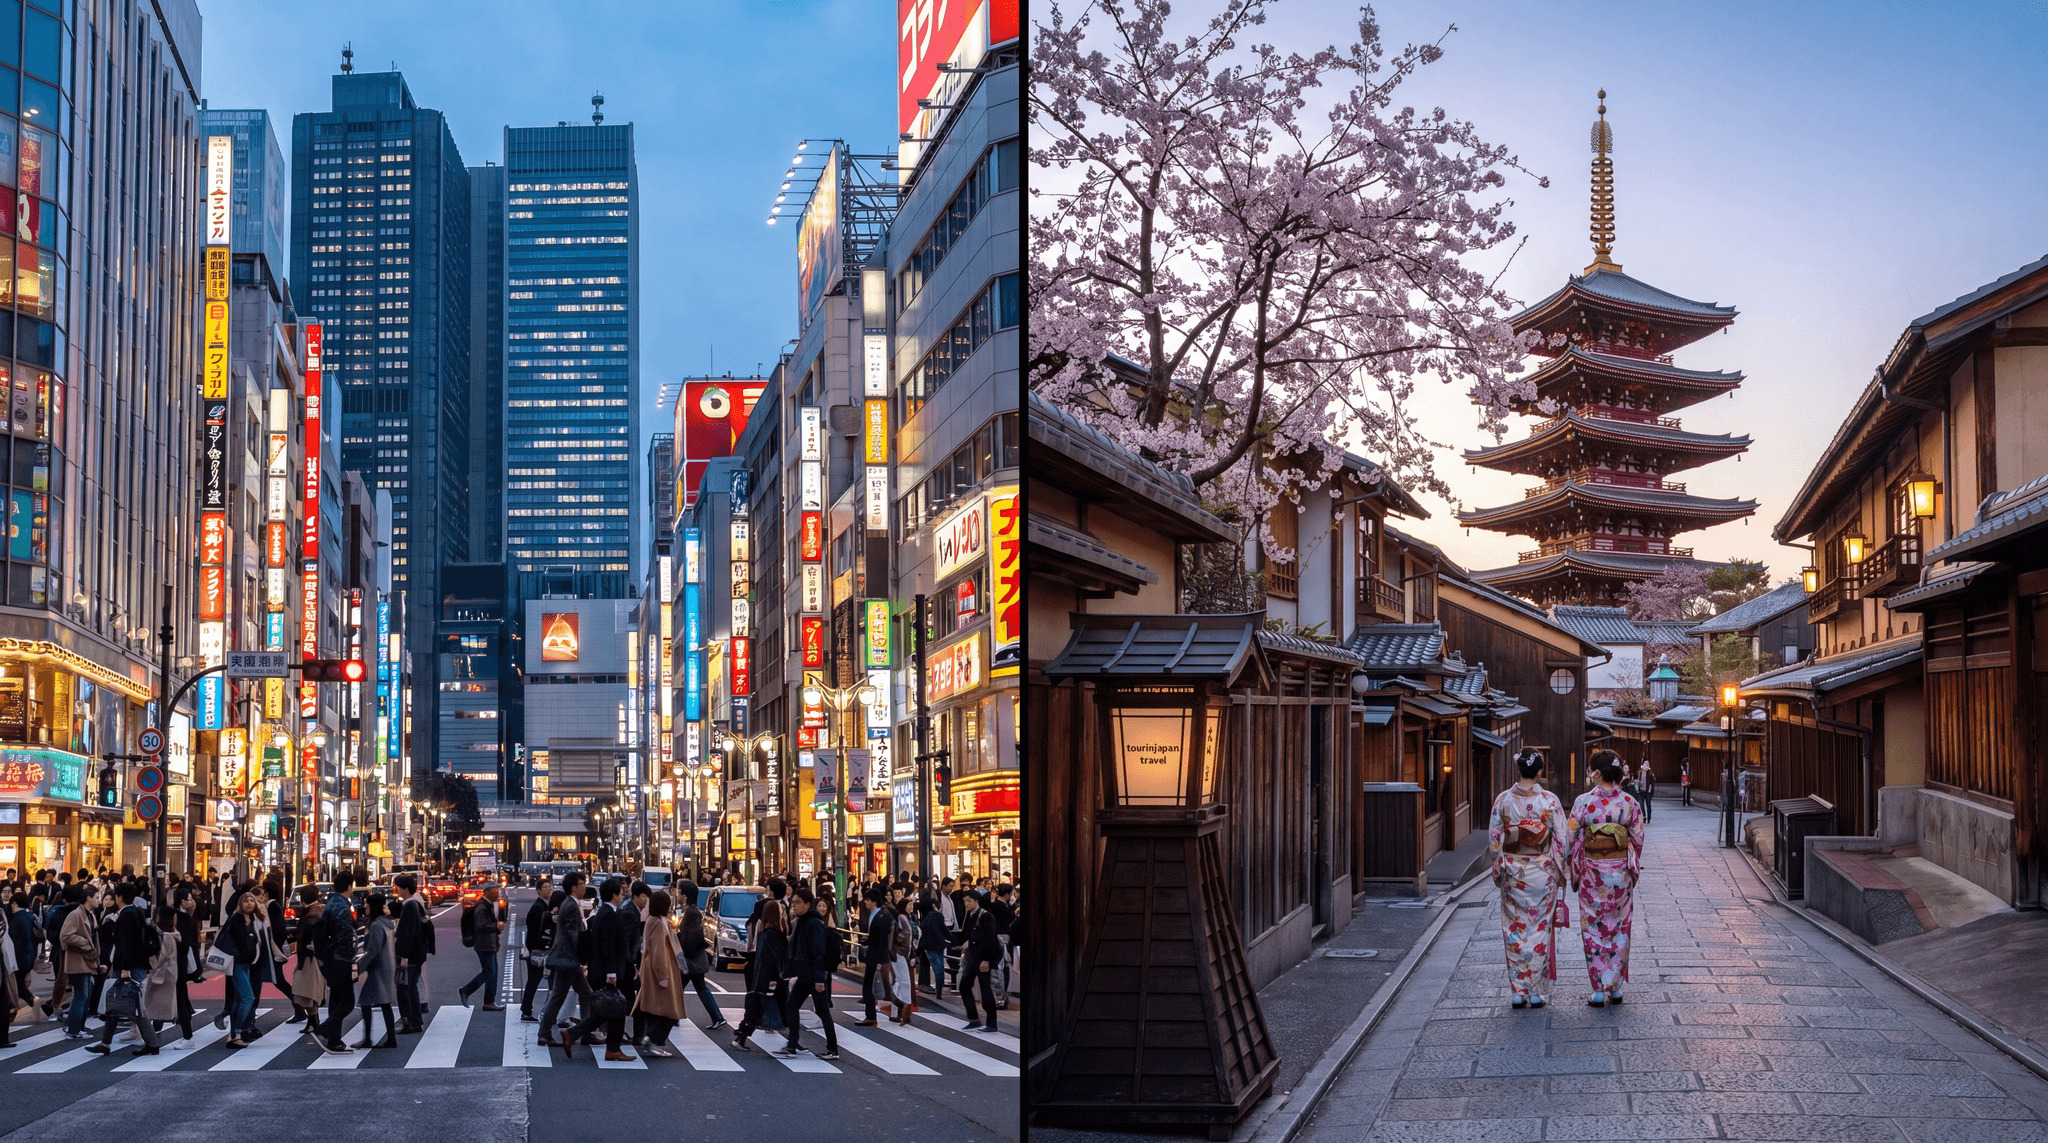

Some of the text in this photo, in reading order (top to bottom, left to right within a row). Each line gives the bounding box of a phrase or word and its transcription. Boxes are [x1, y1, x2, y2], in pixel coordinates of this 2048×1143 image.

[143, 735, 159, 748] 30
[1126, 743, 1180, 754] tourinjapan
[1140, 756, 1167, 765] travel
